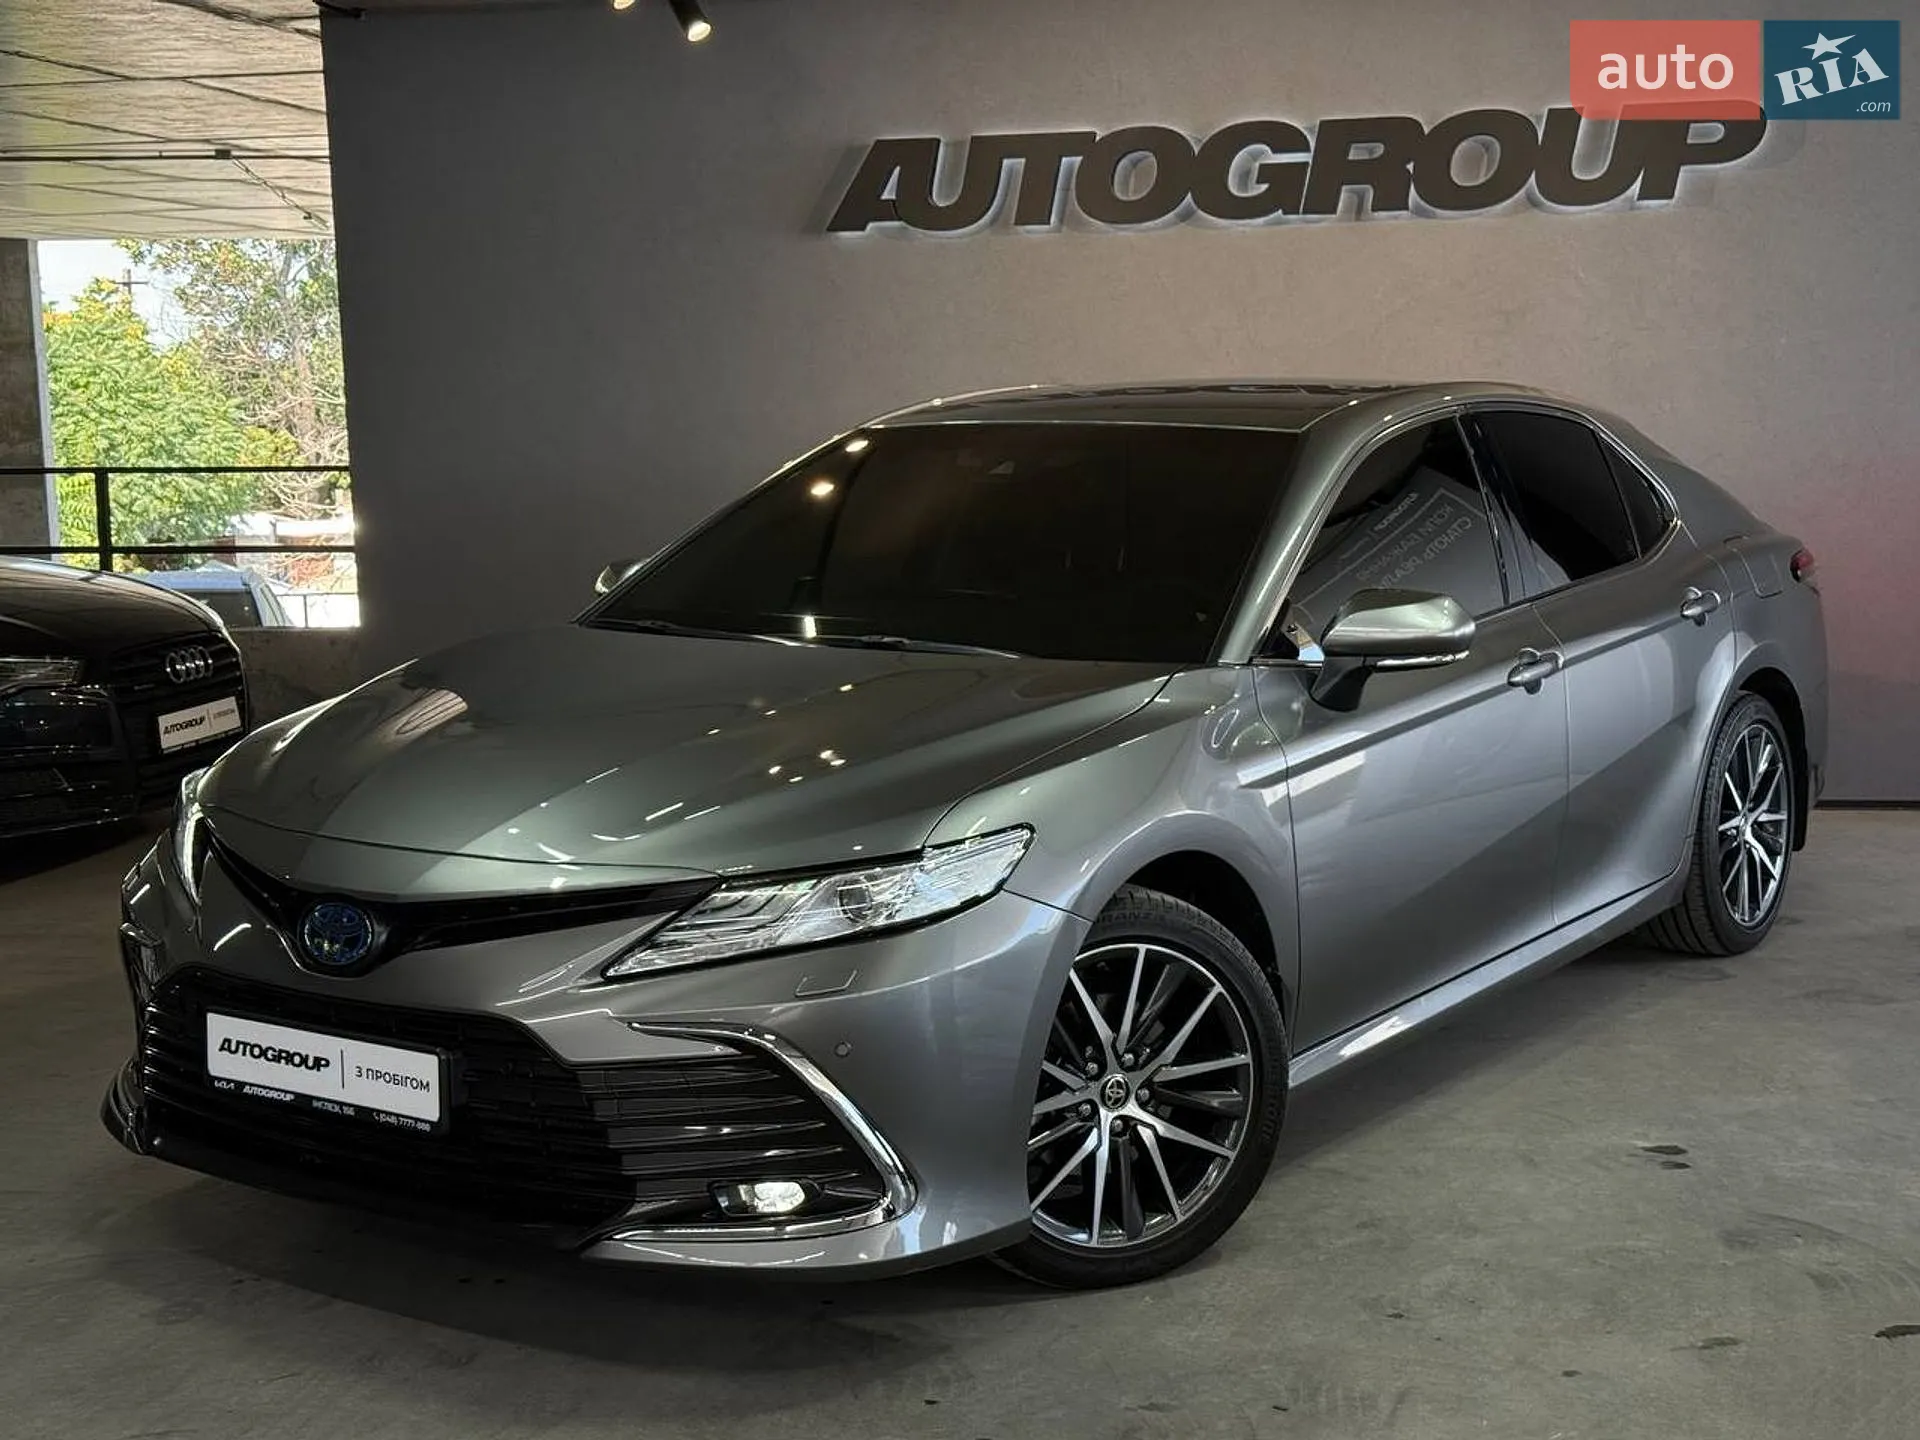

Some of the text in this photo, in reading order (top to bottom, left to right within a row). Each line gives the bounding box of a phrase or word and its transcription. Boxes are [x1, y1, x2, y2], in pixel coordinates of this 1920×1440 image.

[826, 99, 1767, 233] AUTOGROUP
[218, 1037, 330, 1073] AUTOGROUP
[243, 1085, 296, 1102] AUTOGROUP
[366, 1068, 431, 1094] ПРОБІГОМ
